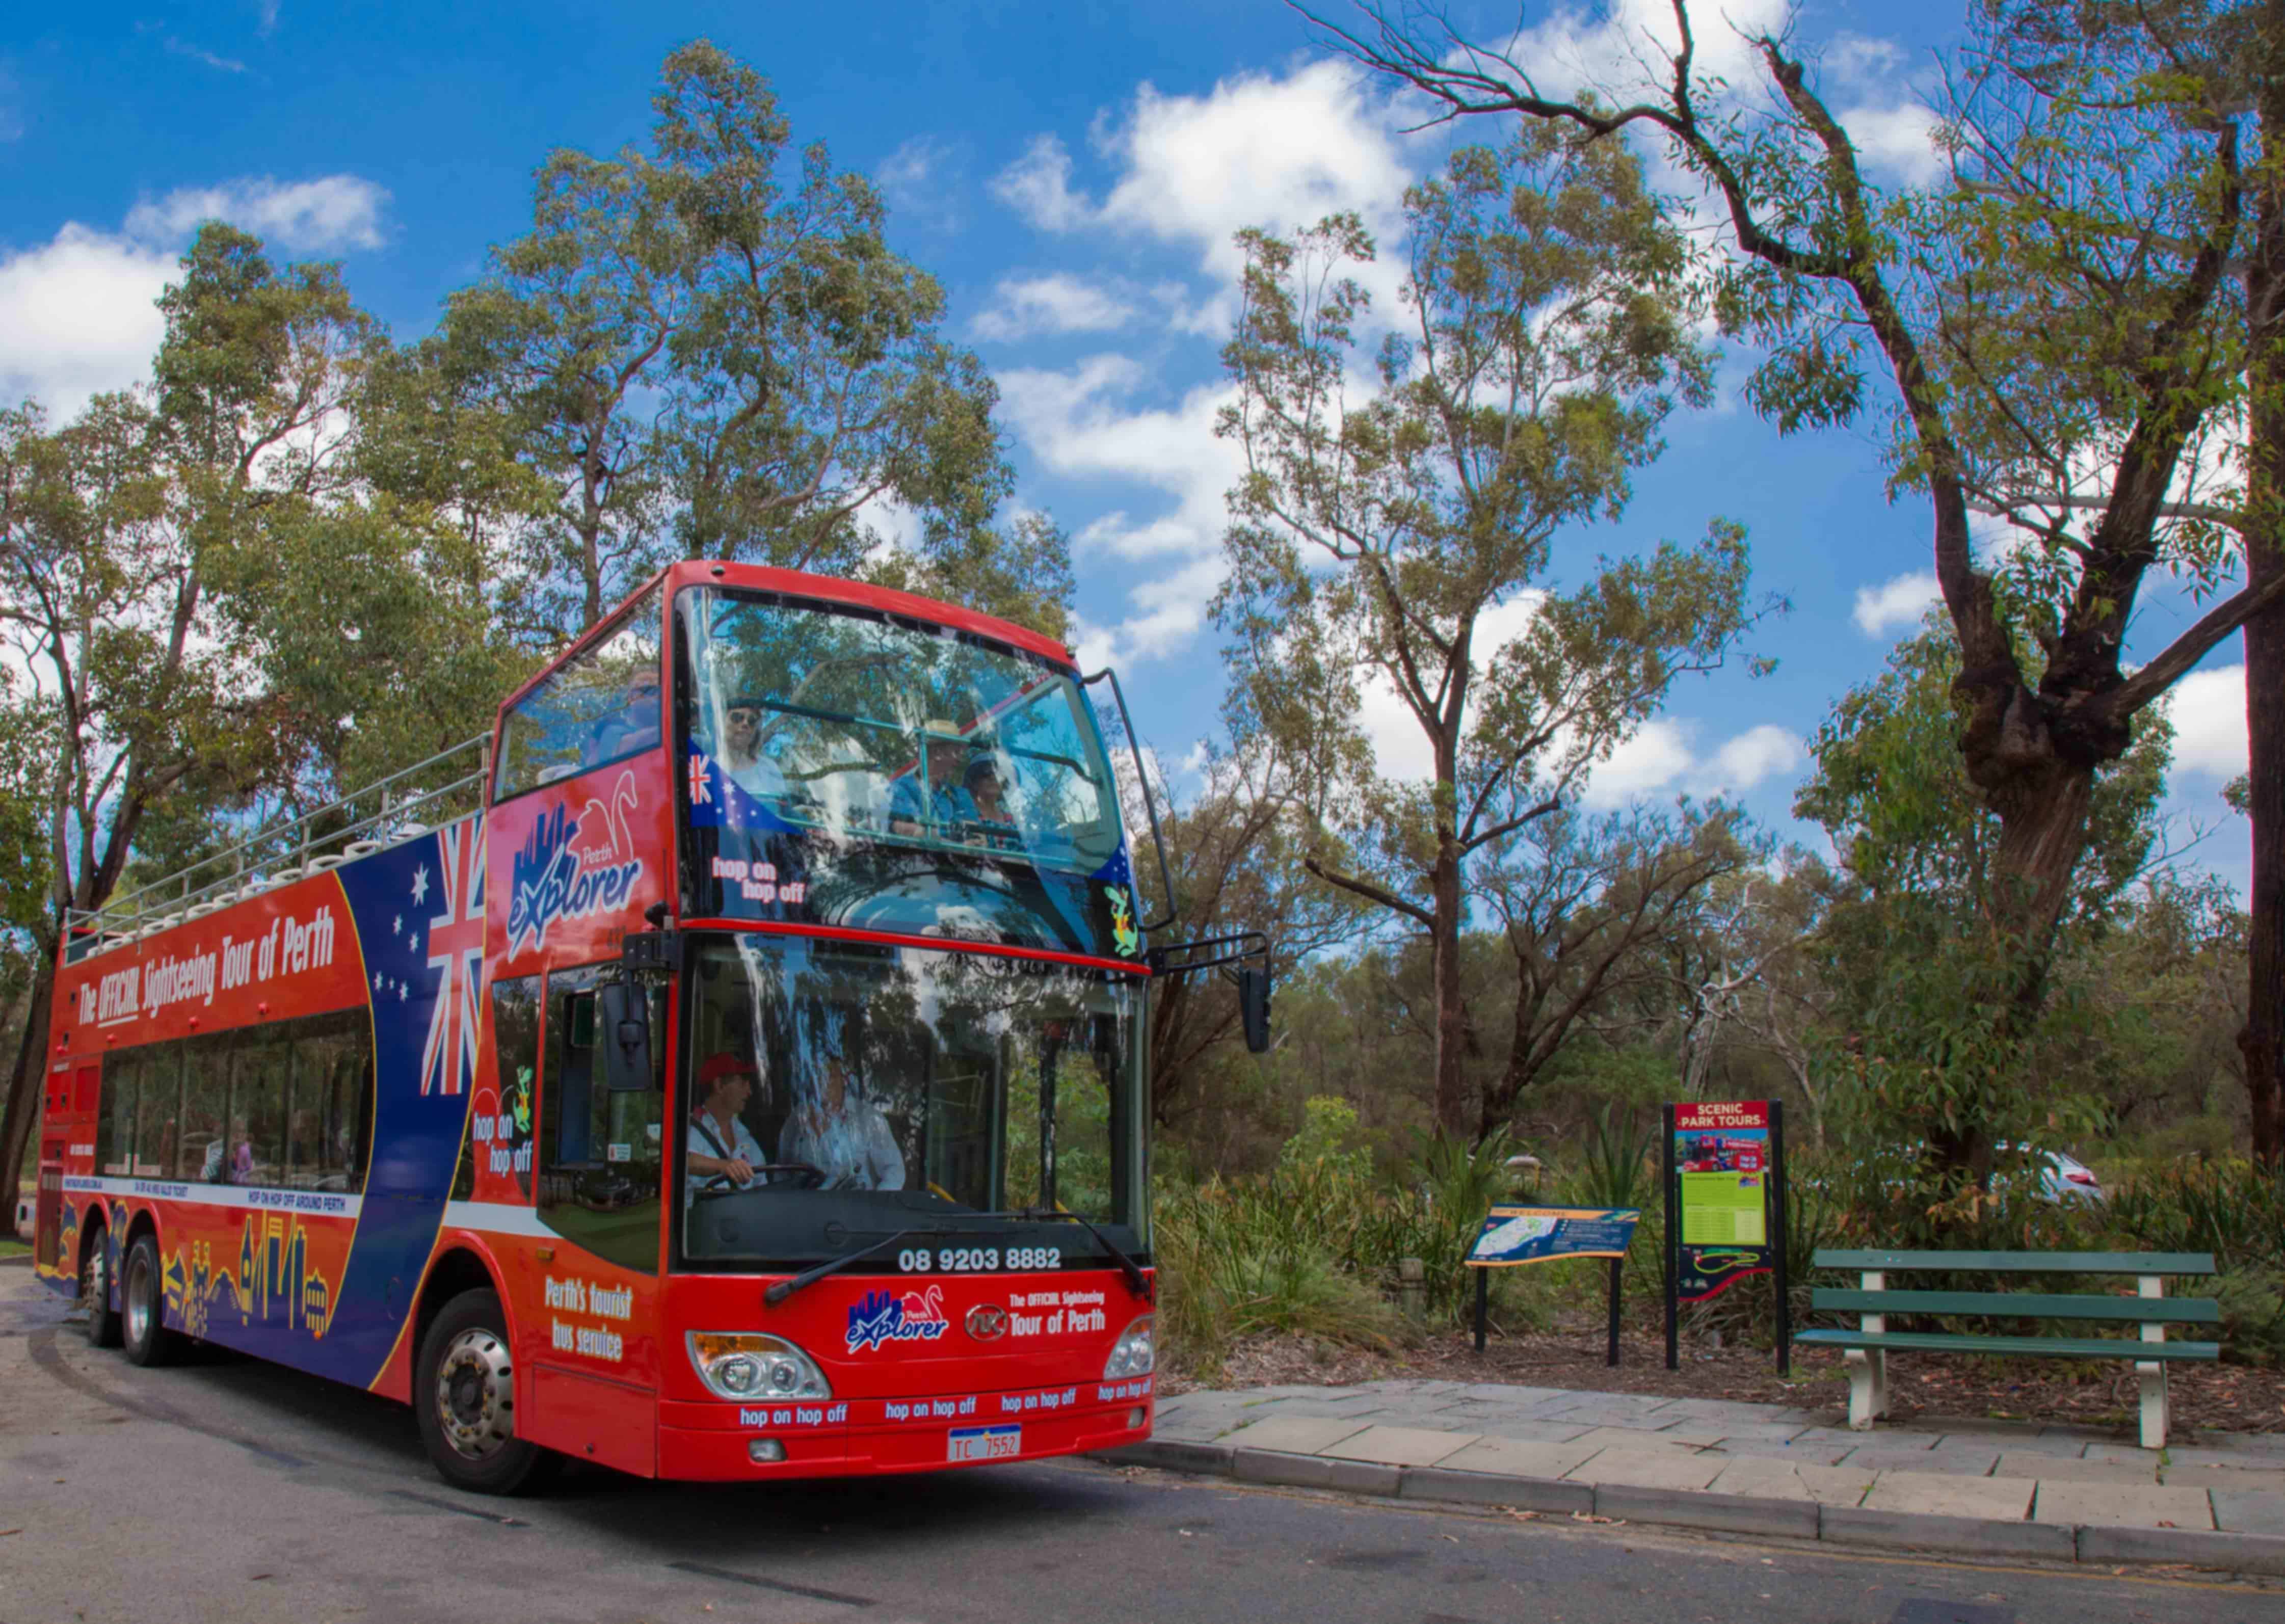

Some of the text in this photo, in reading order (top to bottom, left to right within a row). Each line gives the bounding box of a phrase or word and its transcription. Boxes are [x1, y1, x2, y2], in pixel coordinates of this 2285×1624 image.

[582, 845, 613, 865] Perth
[712, 857, 776, 882] hop on
[741, 878, 805, 903] hop off
[79, 904, 335, 1025] The OFFICIAL Sightseeing Tour of Perth
[1682, 1114, 1761, 1127] PARK TOURS
[1697, 1103, 1743, 1115] SCENIC
[473, 1112, 513, 1144] hop on
[490, 1144, 532, 1176] hop off
[270, 1192, 282, 1206] HOP
[283, 1193, 295, 1207] OFF
[323, 1196, 346, 1211] PERTH
[898, 1247, 1060, 1272] 08 9203 8882
[545, 1275, 632, 1319] Perth's tourist
[1009, 1292, 1105, 1307] The OFFICIAL Sightseeing
[1009, 1308, 1105, 1336] Tour of Perth
[552, 1316, 622, 1362] bus service
[1001, 1388, 1076, 1412] hop on hop off
[1098, 1385, 1114, 1402] hop
[1115, 1386, 1127, 1397] on
[1128, 1382, 1141, 1398] hop
[740, 1404, 848, 1427] hop on hop off
[885, 1397, 976, 1420] hop on hop off
[955, 1436, 1016, 1459] TC 7552
